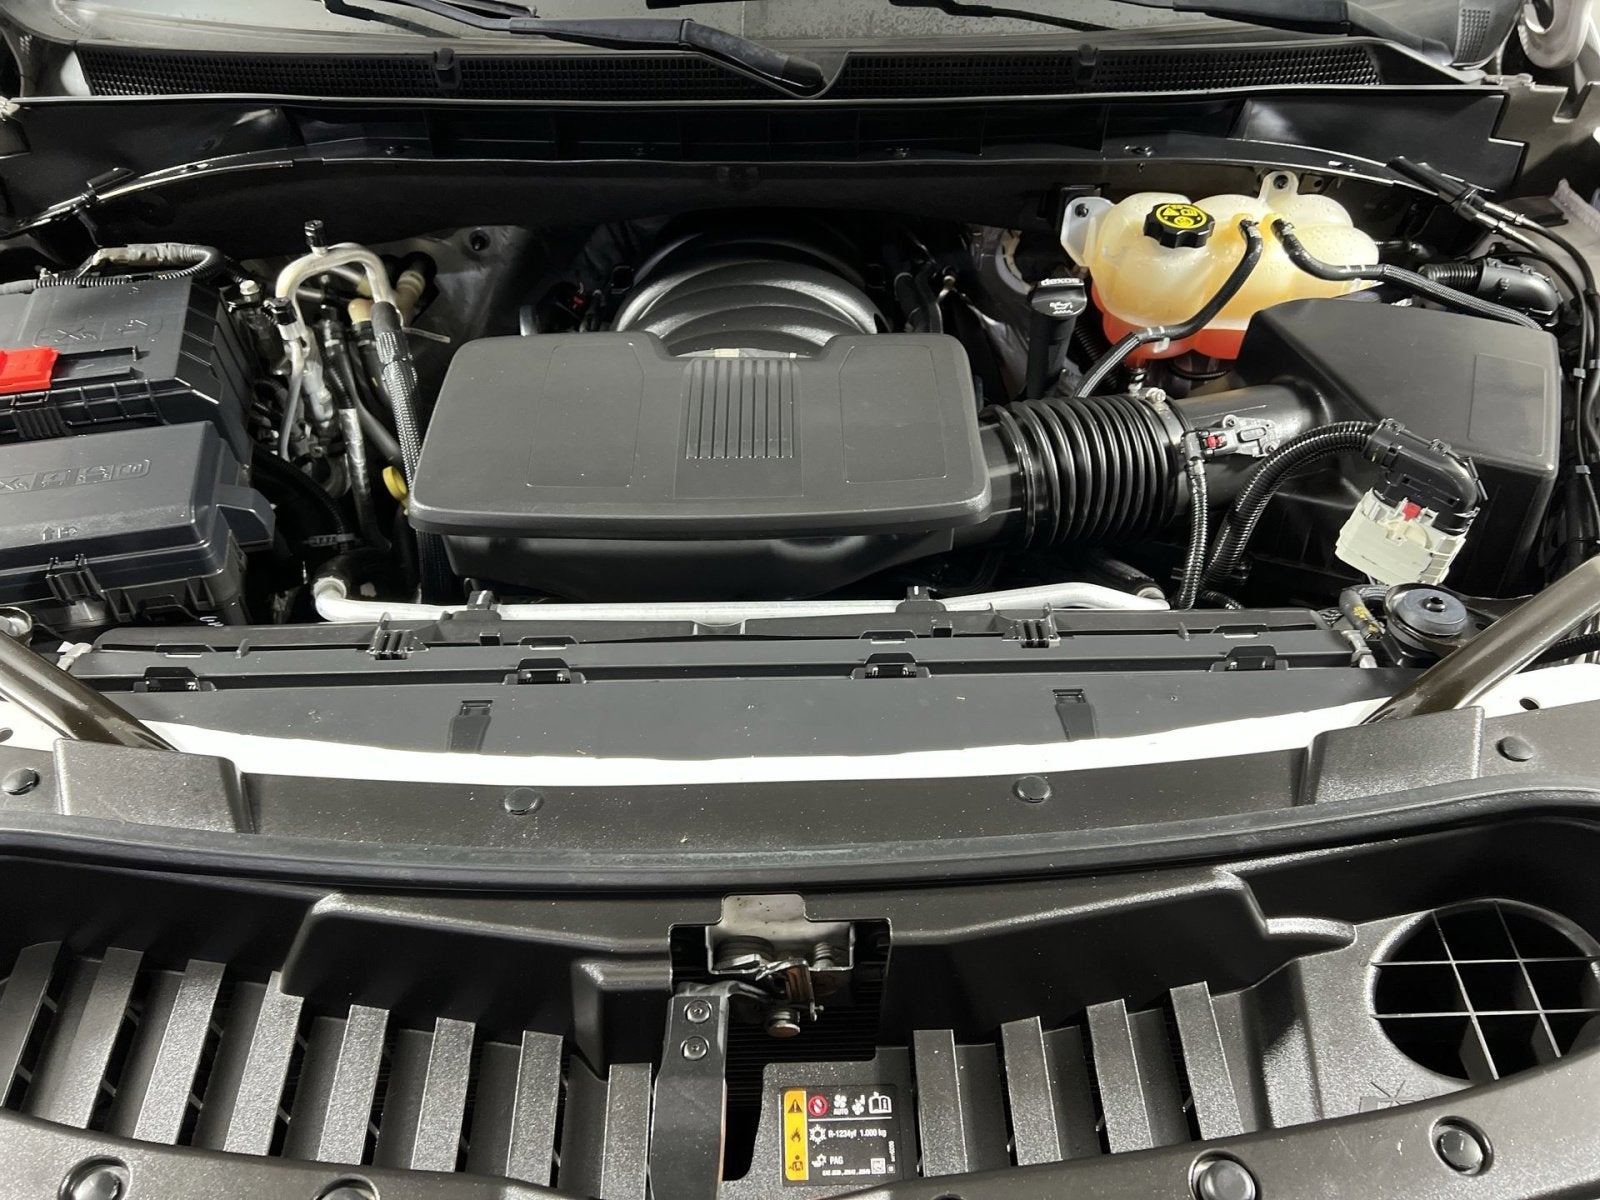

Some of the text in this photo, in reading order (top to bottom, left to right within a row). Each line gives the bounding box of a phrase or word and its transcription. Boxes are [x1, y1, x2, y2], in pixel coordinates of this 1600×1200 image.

[828, 1128, 887, 1138] R-1234yf 1.000 kg
[829, 1156, 844, 1165] PAG
